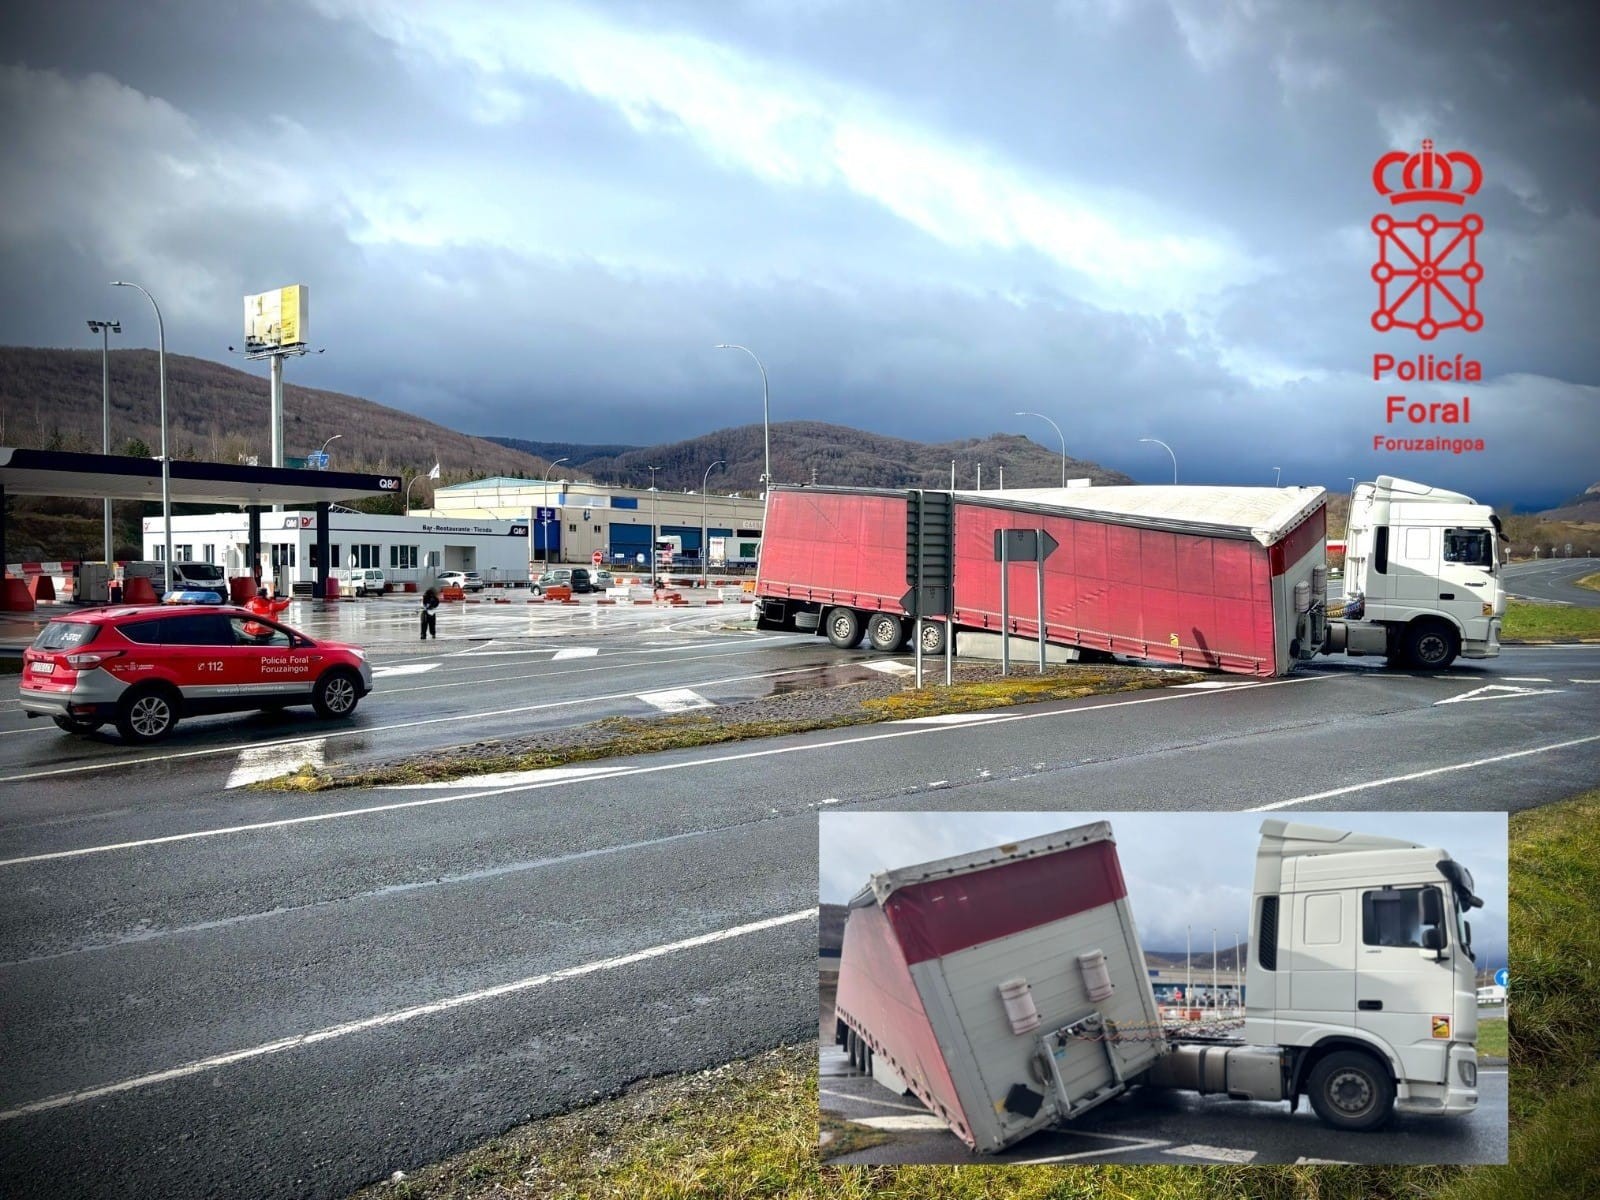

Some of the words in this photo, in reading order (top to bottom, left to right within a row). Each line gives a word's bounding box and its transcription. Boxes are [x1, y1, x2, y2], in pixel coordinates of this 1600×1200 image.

[379, 478, 393, 489] Q8
[261, 656, 287, 665] Policía
[289, 655, 309, 664] Foral
[207, 661, 224, 671] 112
[261, 665, 309, 674] Foruzaingoa
